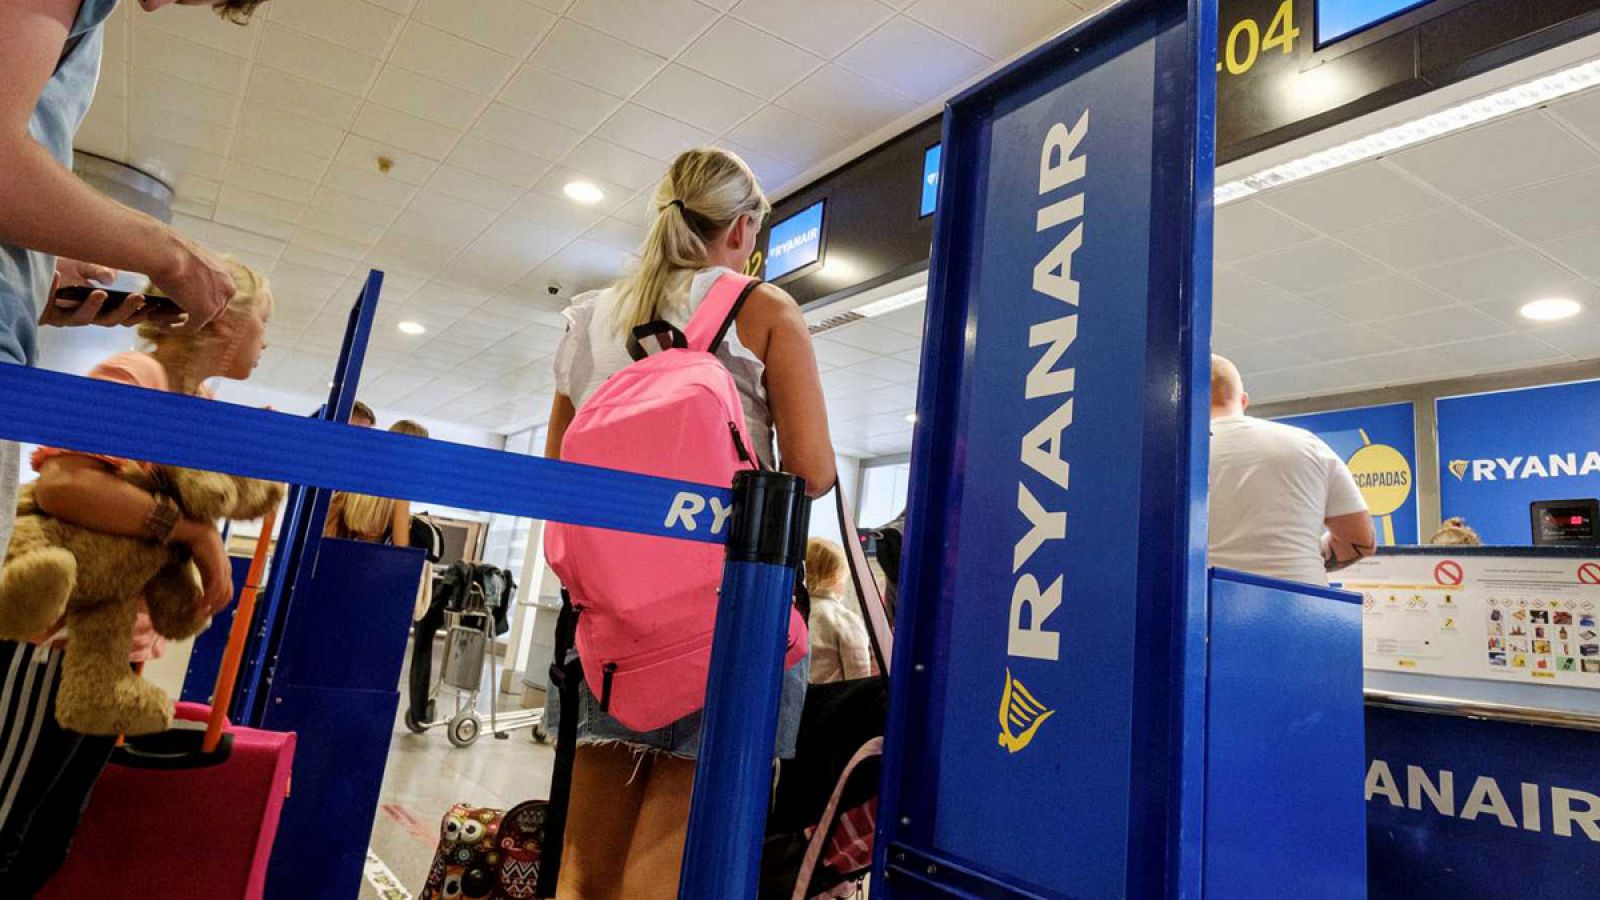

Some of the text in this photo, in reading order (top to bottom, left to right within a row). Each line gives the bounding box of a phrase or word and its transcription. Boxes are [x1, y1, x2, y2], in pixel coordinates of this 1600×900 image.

[1216, 0, 1300, 75] 04
[1007, 107, 1090, 661] RYANAIR
[1472, 451, 1600, 481] RYANA
[664, 491, 733, 534] RY
[1364, 759, 1600, 843] ANAIR
